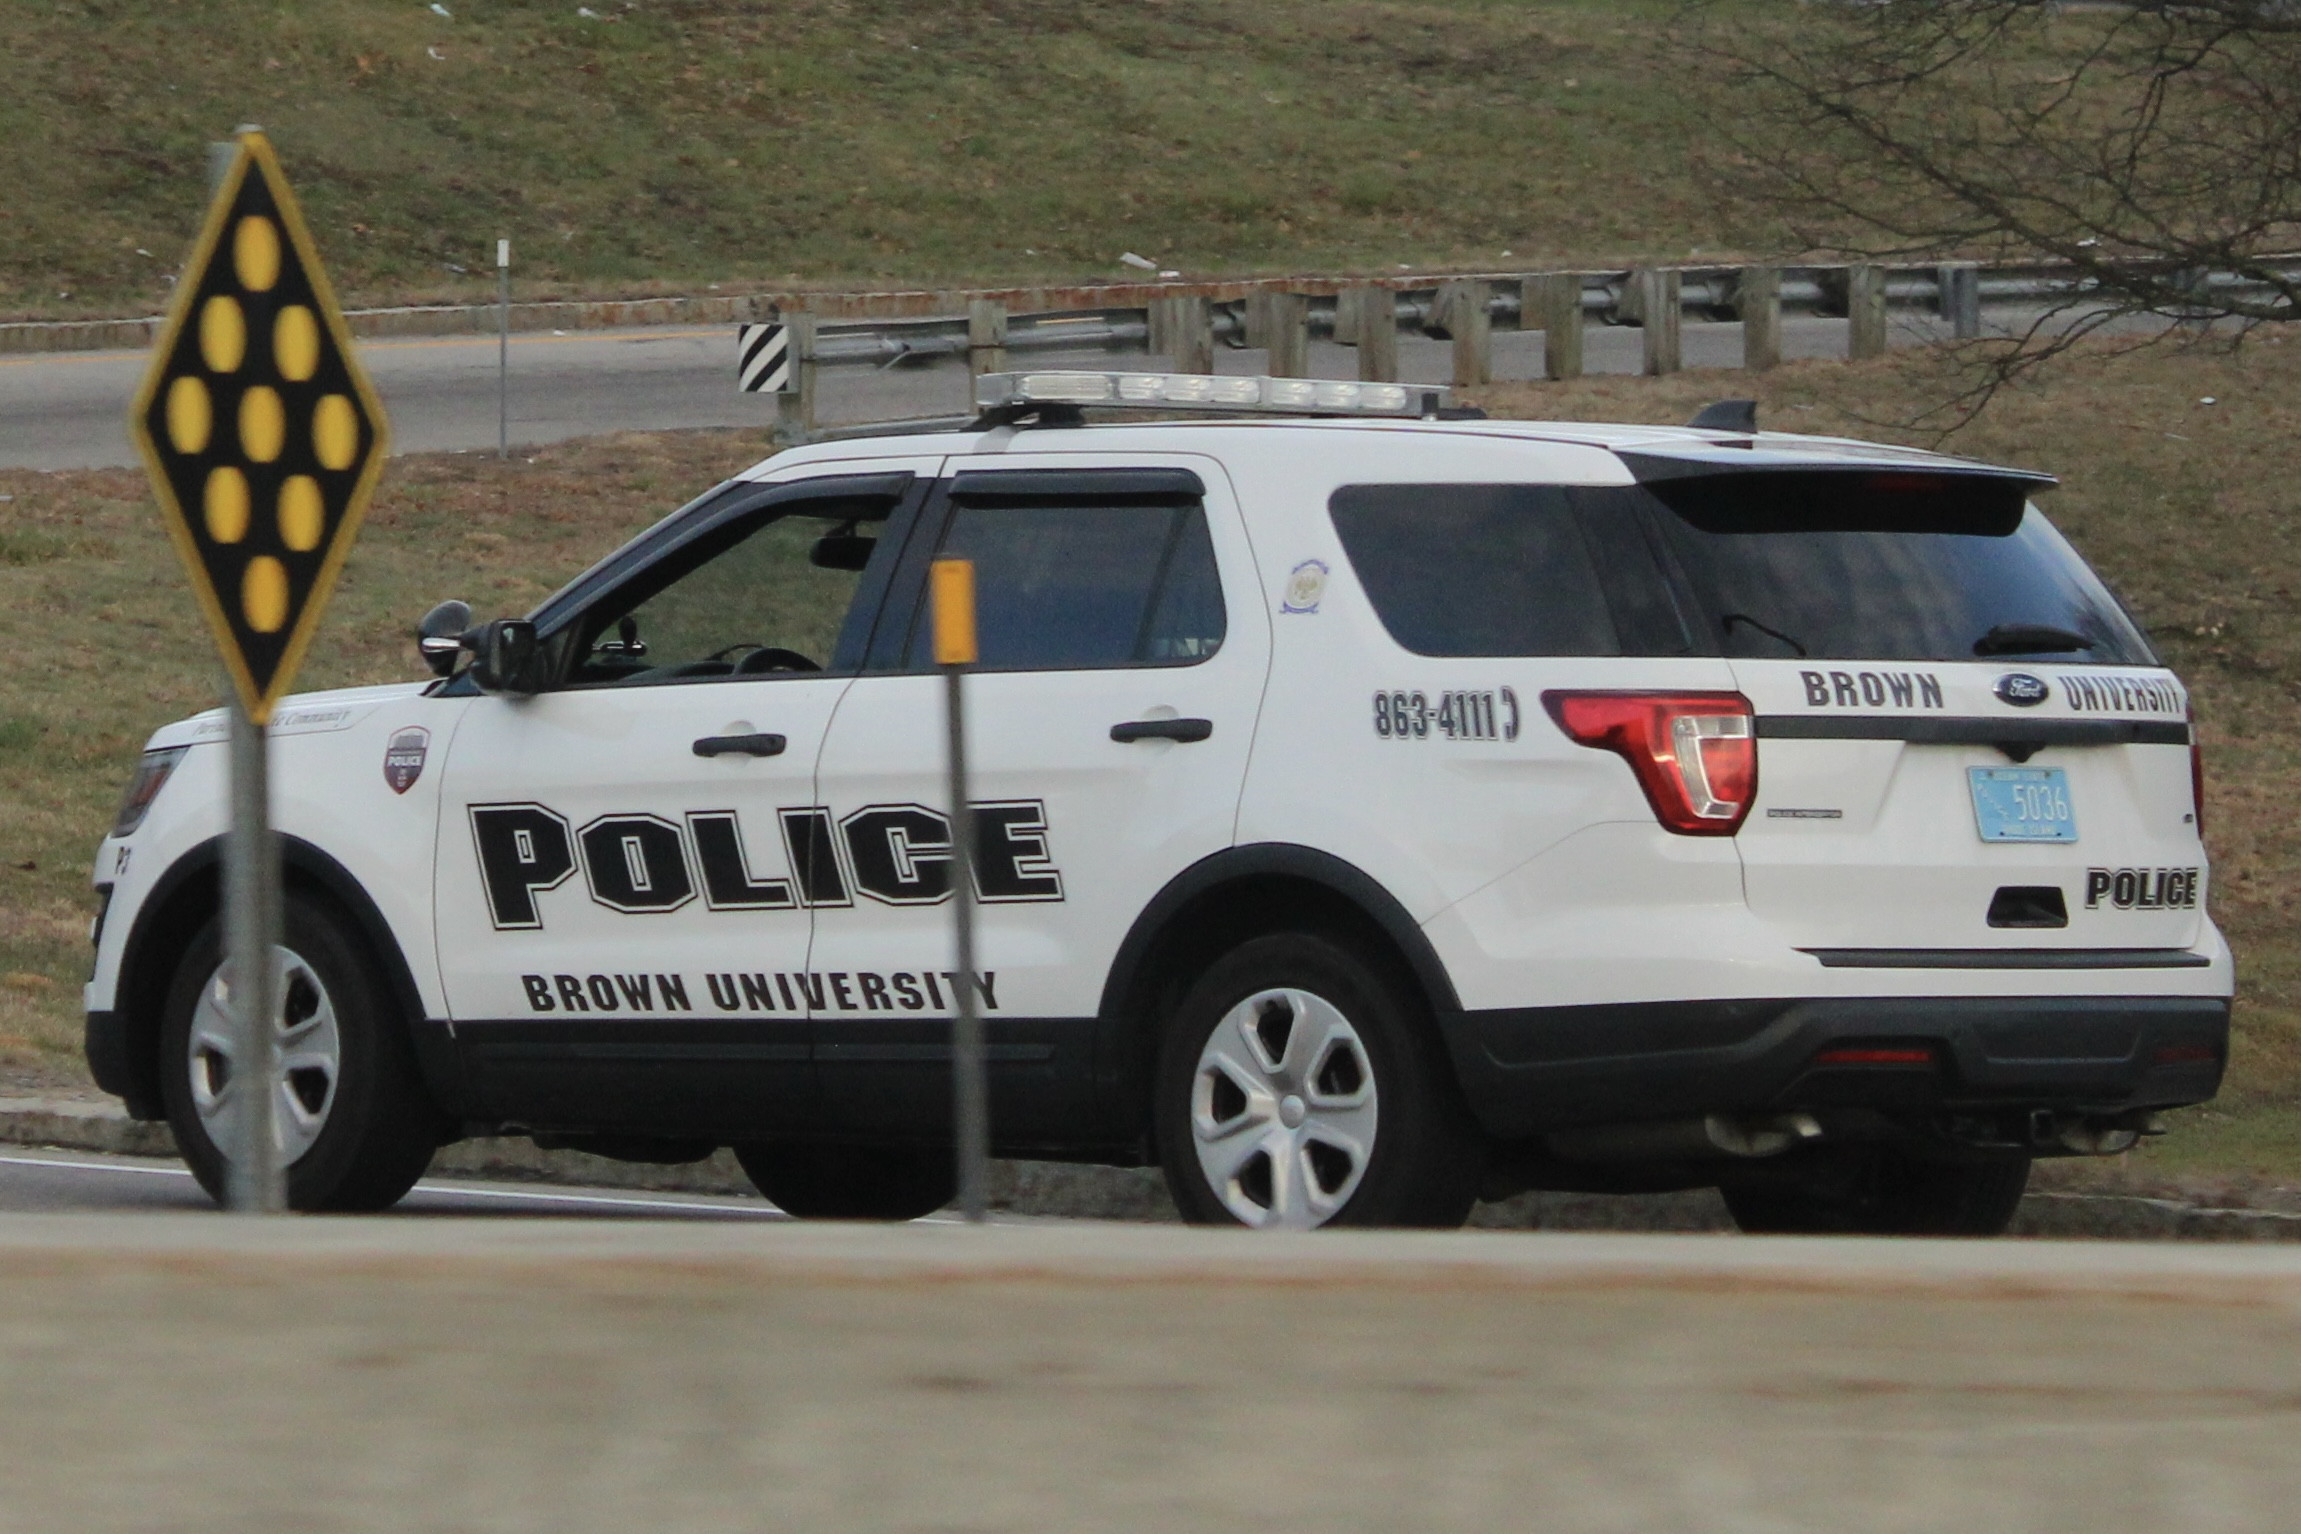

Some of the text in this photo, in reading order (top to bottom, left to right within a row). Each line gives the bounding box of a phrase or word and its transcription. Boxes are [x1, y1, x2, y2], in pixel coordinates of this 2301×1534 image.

[1799, 671, 2182, 714] BROWN UNIVERSITY
[2009, 677, 2043, 698] Ford
[1373, 689, 1498, 741] 863-4111
[387, 755, 421, 768] POLICE
[2012, 783, 2069, 822] 5036
[466, 799, 1066, 931] POLICE
[2085, 866, 2199, 910] POLICE
[522, 971, 1000, 1012] BROWN UNIVERSITY
